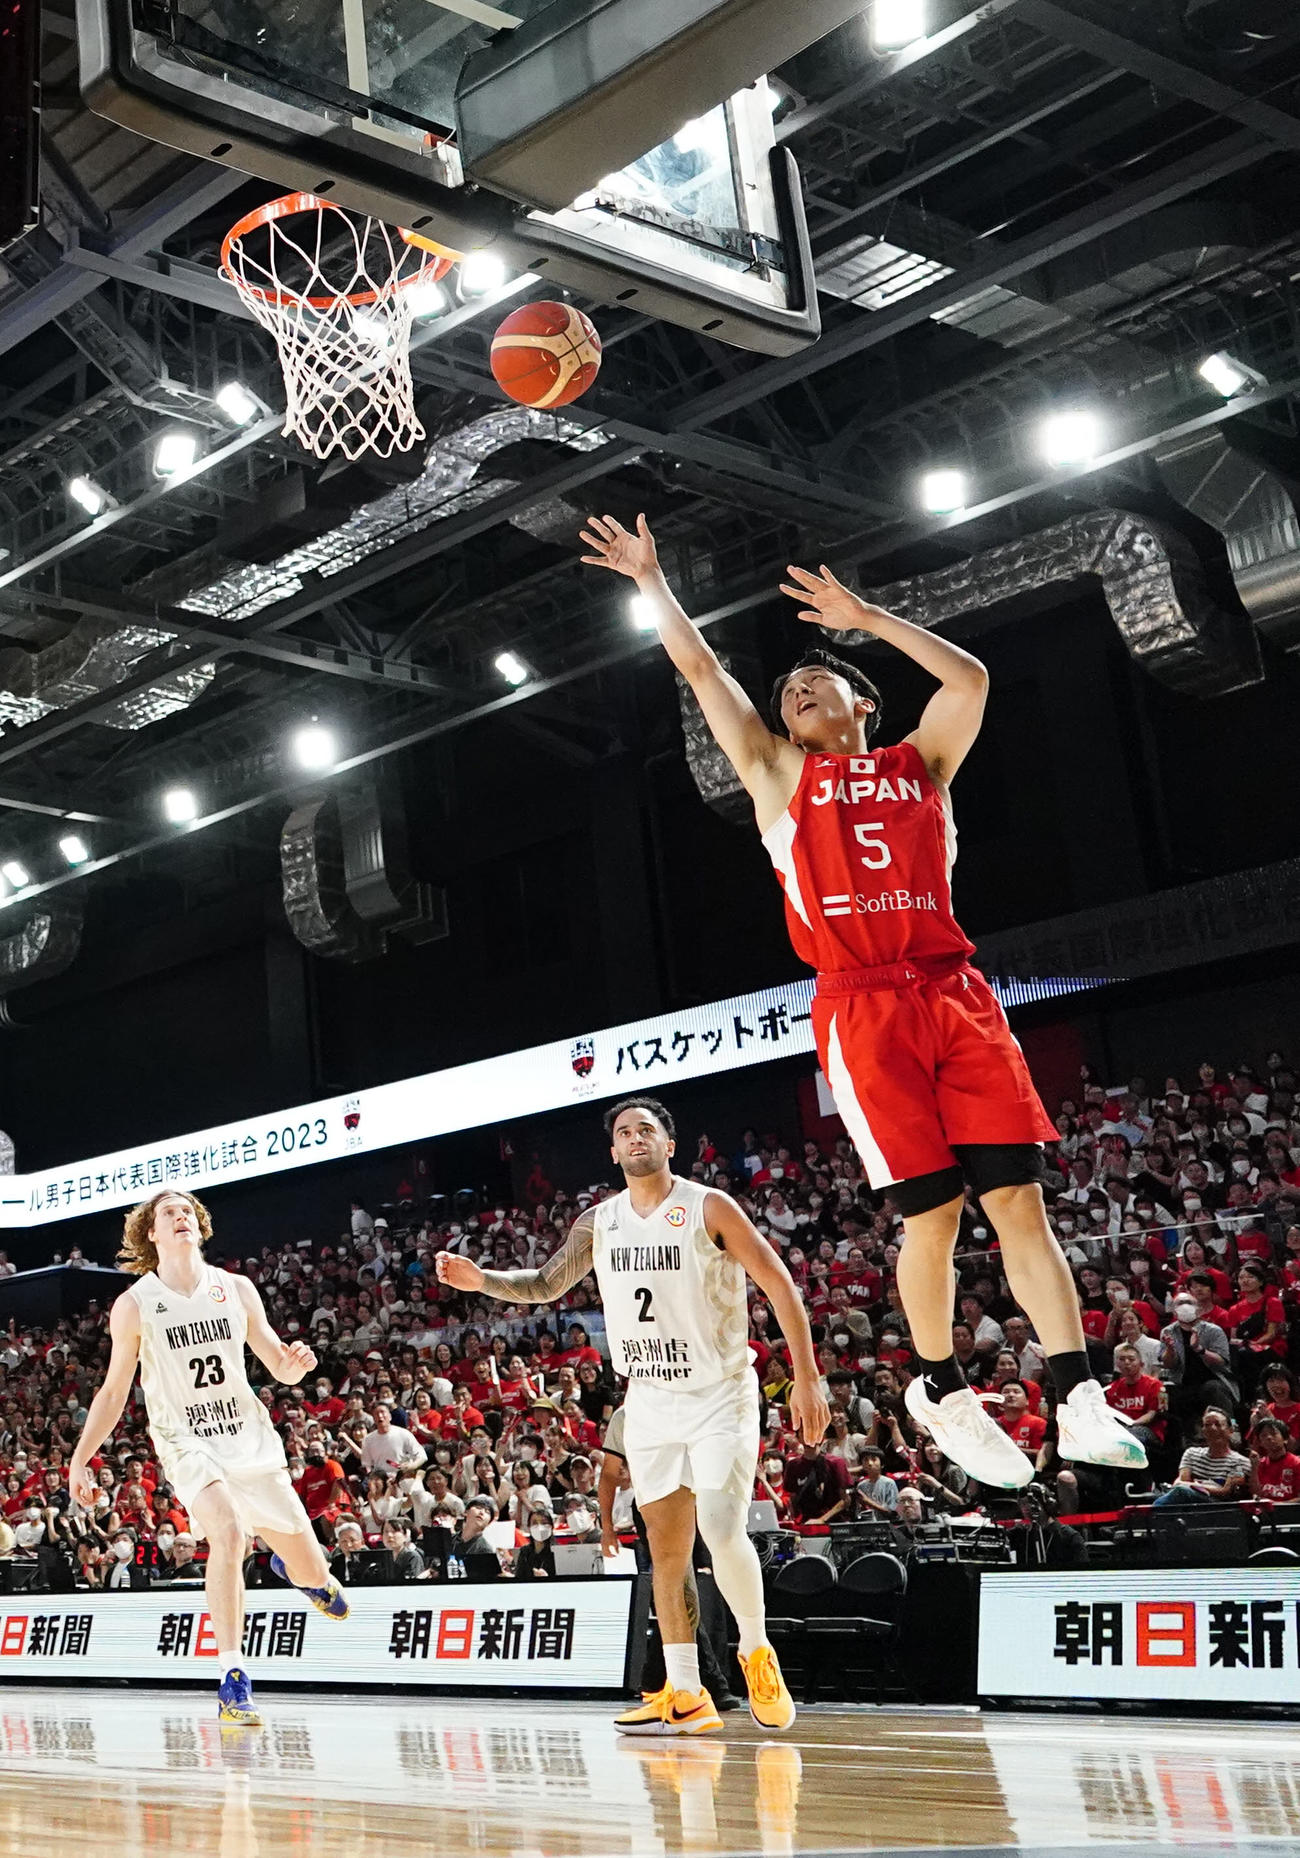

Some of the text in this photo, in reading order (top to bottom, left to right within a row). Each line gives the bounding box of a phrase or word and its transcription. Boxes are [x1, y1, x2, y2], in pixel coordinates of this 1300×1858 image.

[811, 777, 923, 806] JAPAN
[853, 822, 892, 870] 5
[266, 1118, 329, 1157] 2023
[610, 1245, 681, 1272] NEW ZEALAND
[634, 1287, 656, 1323] 2
[165, 1317, 232, 1350] NEW ZEALAND
[622, 1338, 690, 1363] 澳洲虎
[189, 1354, 226, 1389] 23
[0, 1614, 94, 1656] 日新聞
[389, 1608, 575, 1660] 朝日新聞
[1054, 1600, 1300, 1668] 朝日新
